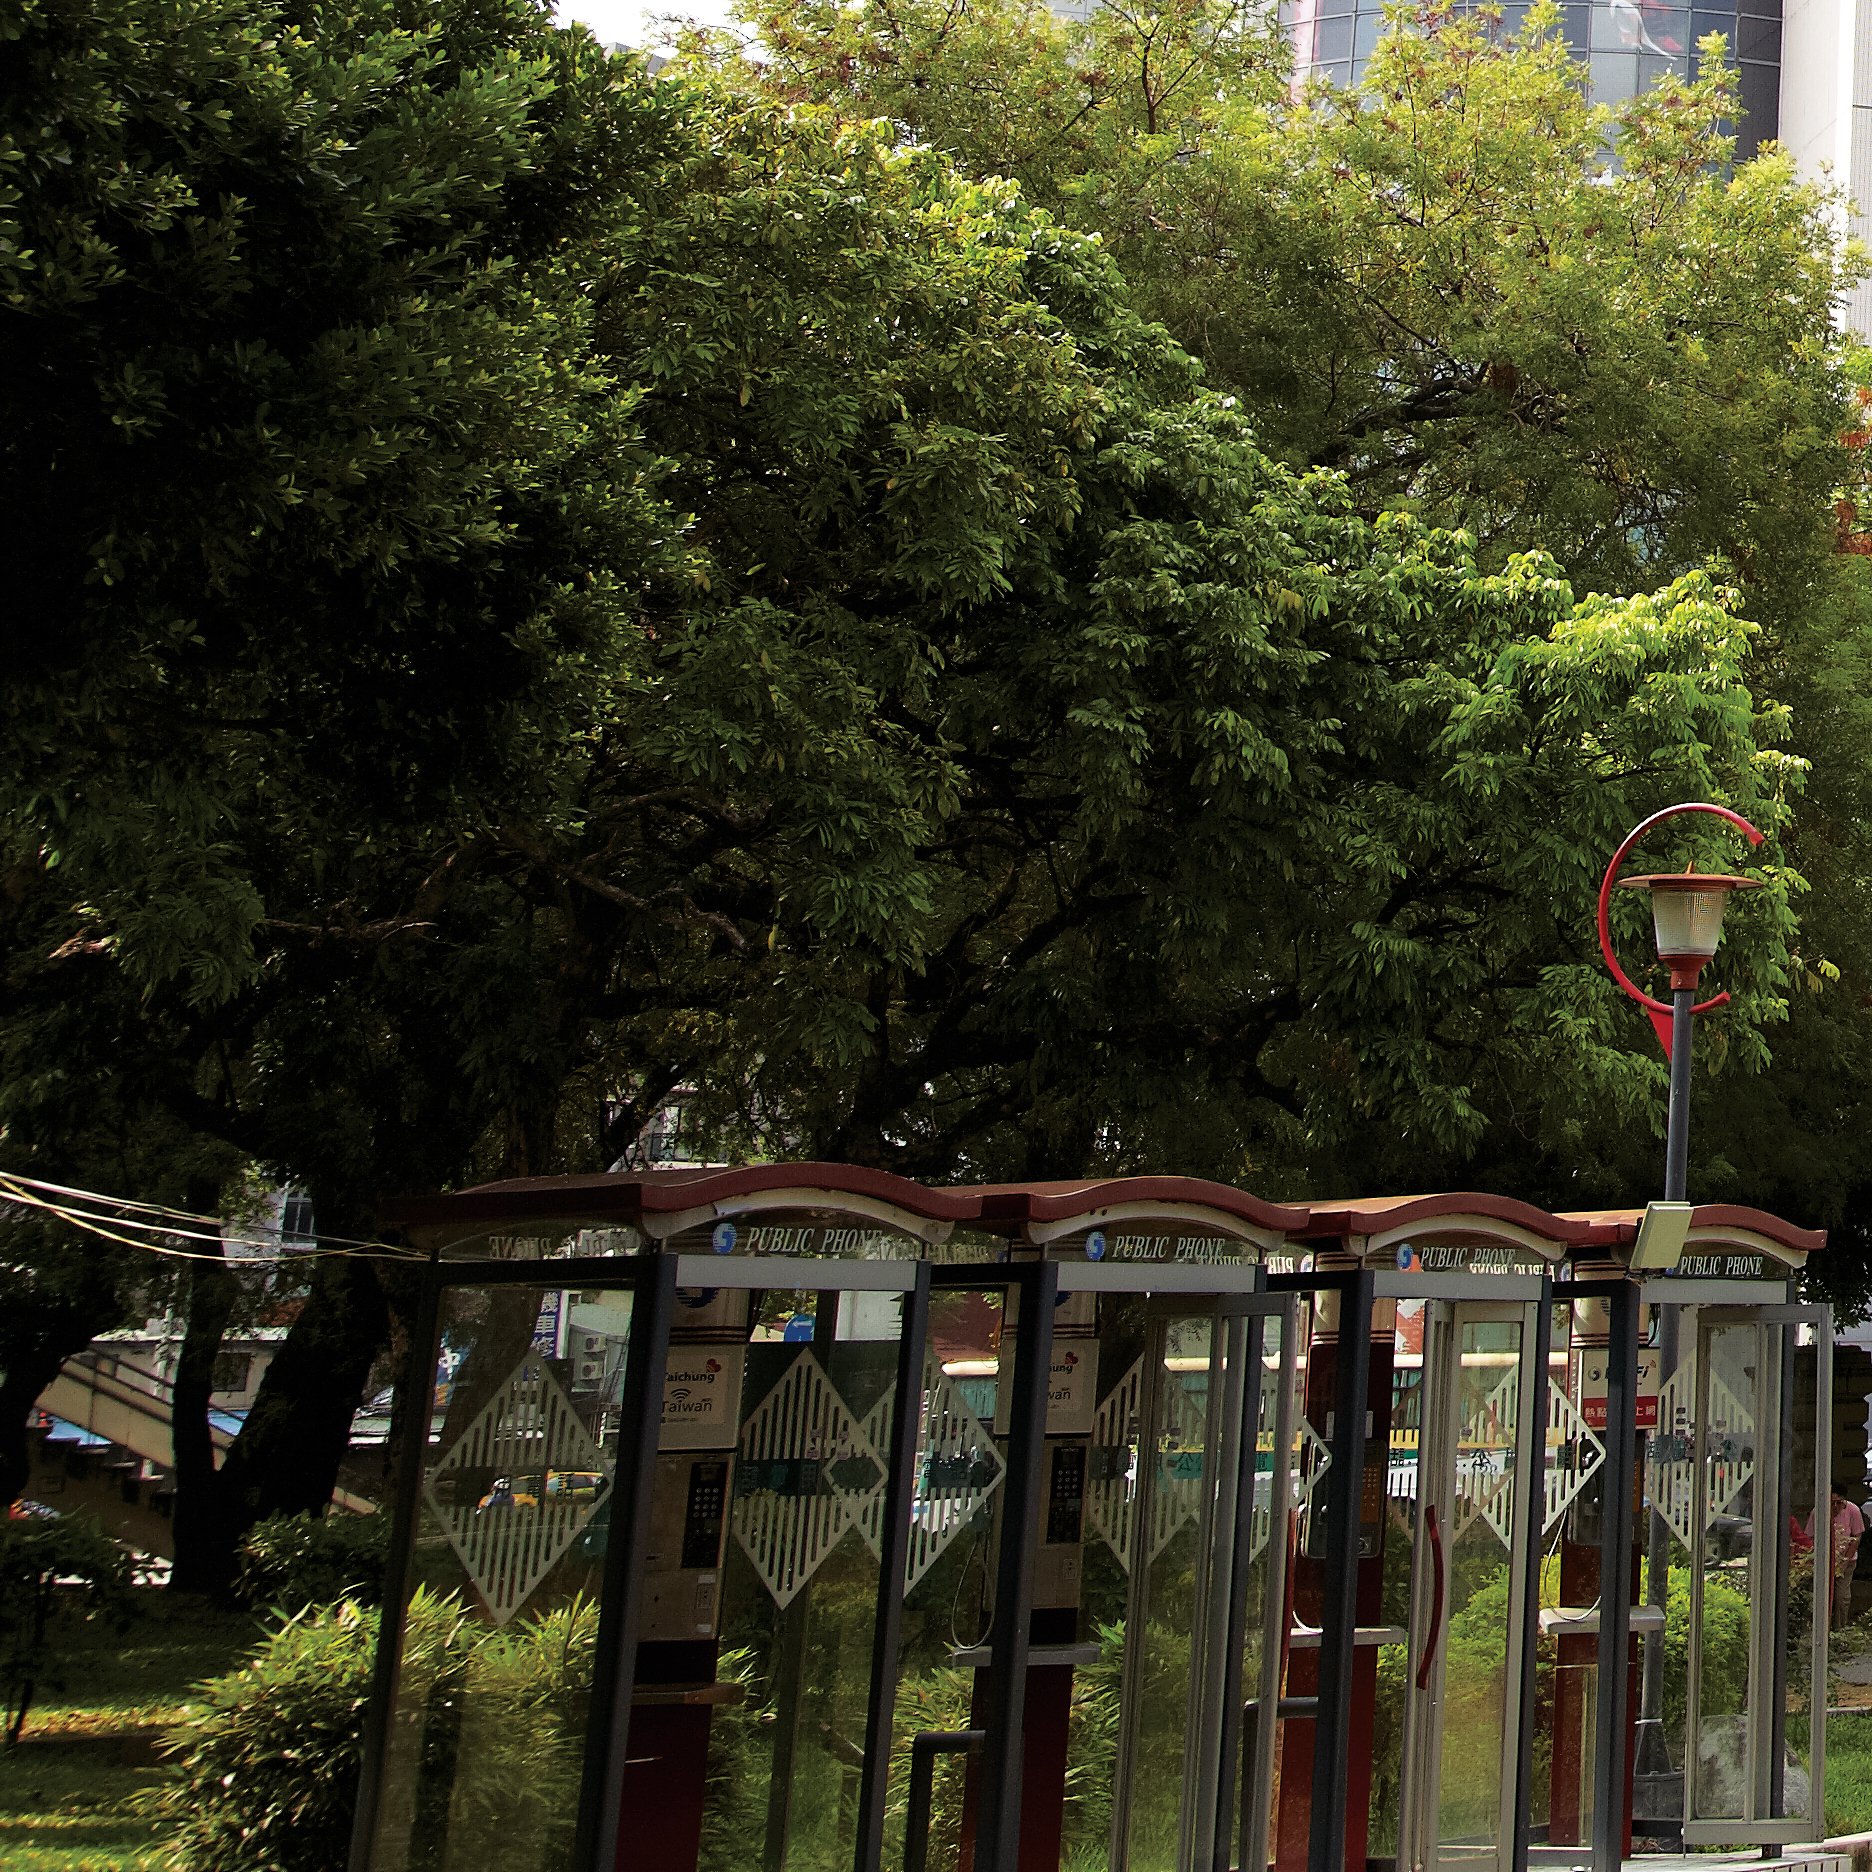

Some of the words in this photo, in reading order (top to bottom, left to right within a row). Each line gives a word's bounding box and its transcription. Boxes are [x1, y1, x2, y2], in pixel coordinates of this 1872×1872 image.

[744, 1226, 816, 1252] PUBLIC
[820, 1228, 884, 1254] PHONE
[1111, 1235, 1170, 1259] PUBLIC
[1174, 1237, 1226, 1260] PHONE
[1420, 1246, 1468, 1267] PUBLIC
[1472, 1248, 1516, 1269] PHONE
[1679, 1257, 1721, 1275] PUBLIC
[1725, 1257, 1763, 1275] PHONE
